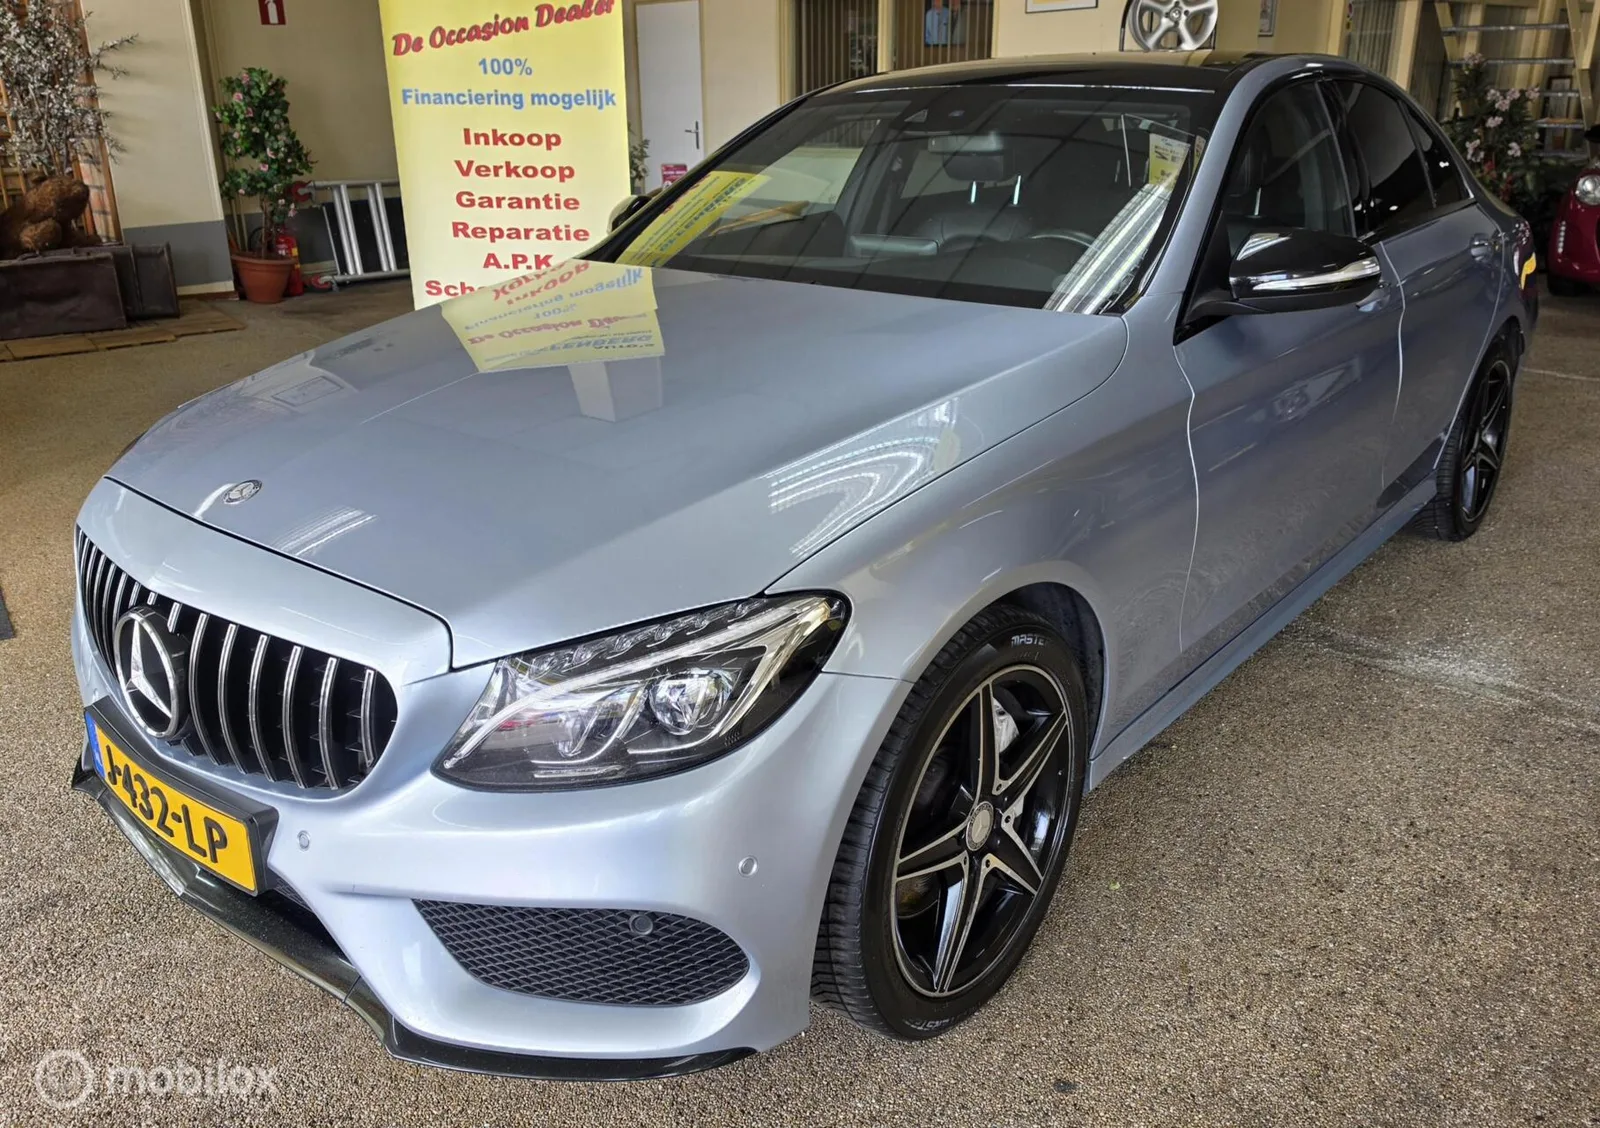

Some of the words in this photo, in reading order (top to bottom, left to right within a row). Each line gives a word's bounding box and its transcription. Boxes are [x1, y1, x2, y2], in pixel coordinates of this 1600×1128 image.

[392, 33, 424, 56] De
[429, 13, 529, 49] Occasion
[535, 0, 615, 28] Dealer
[478, 58, 533, 76] 100%
[402, 88, 524, 110] Financiering
[530, 89, 617, 110] mogelijk
[463, 128, 562, 150] Inkoop
[454, 160, 575, 182] Verkoop
[455, 190, 580, 210] Garantie
[451, 221, 590, 243] Reparatie
[425, 280, 488, 297] Sch
[106, 744, 228, 863] J-432-LP
